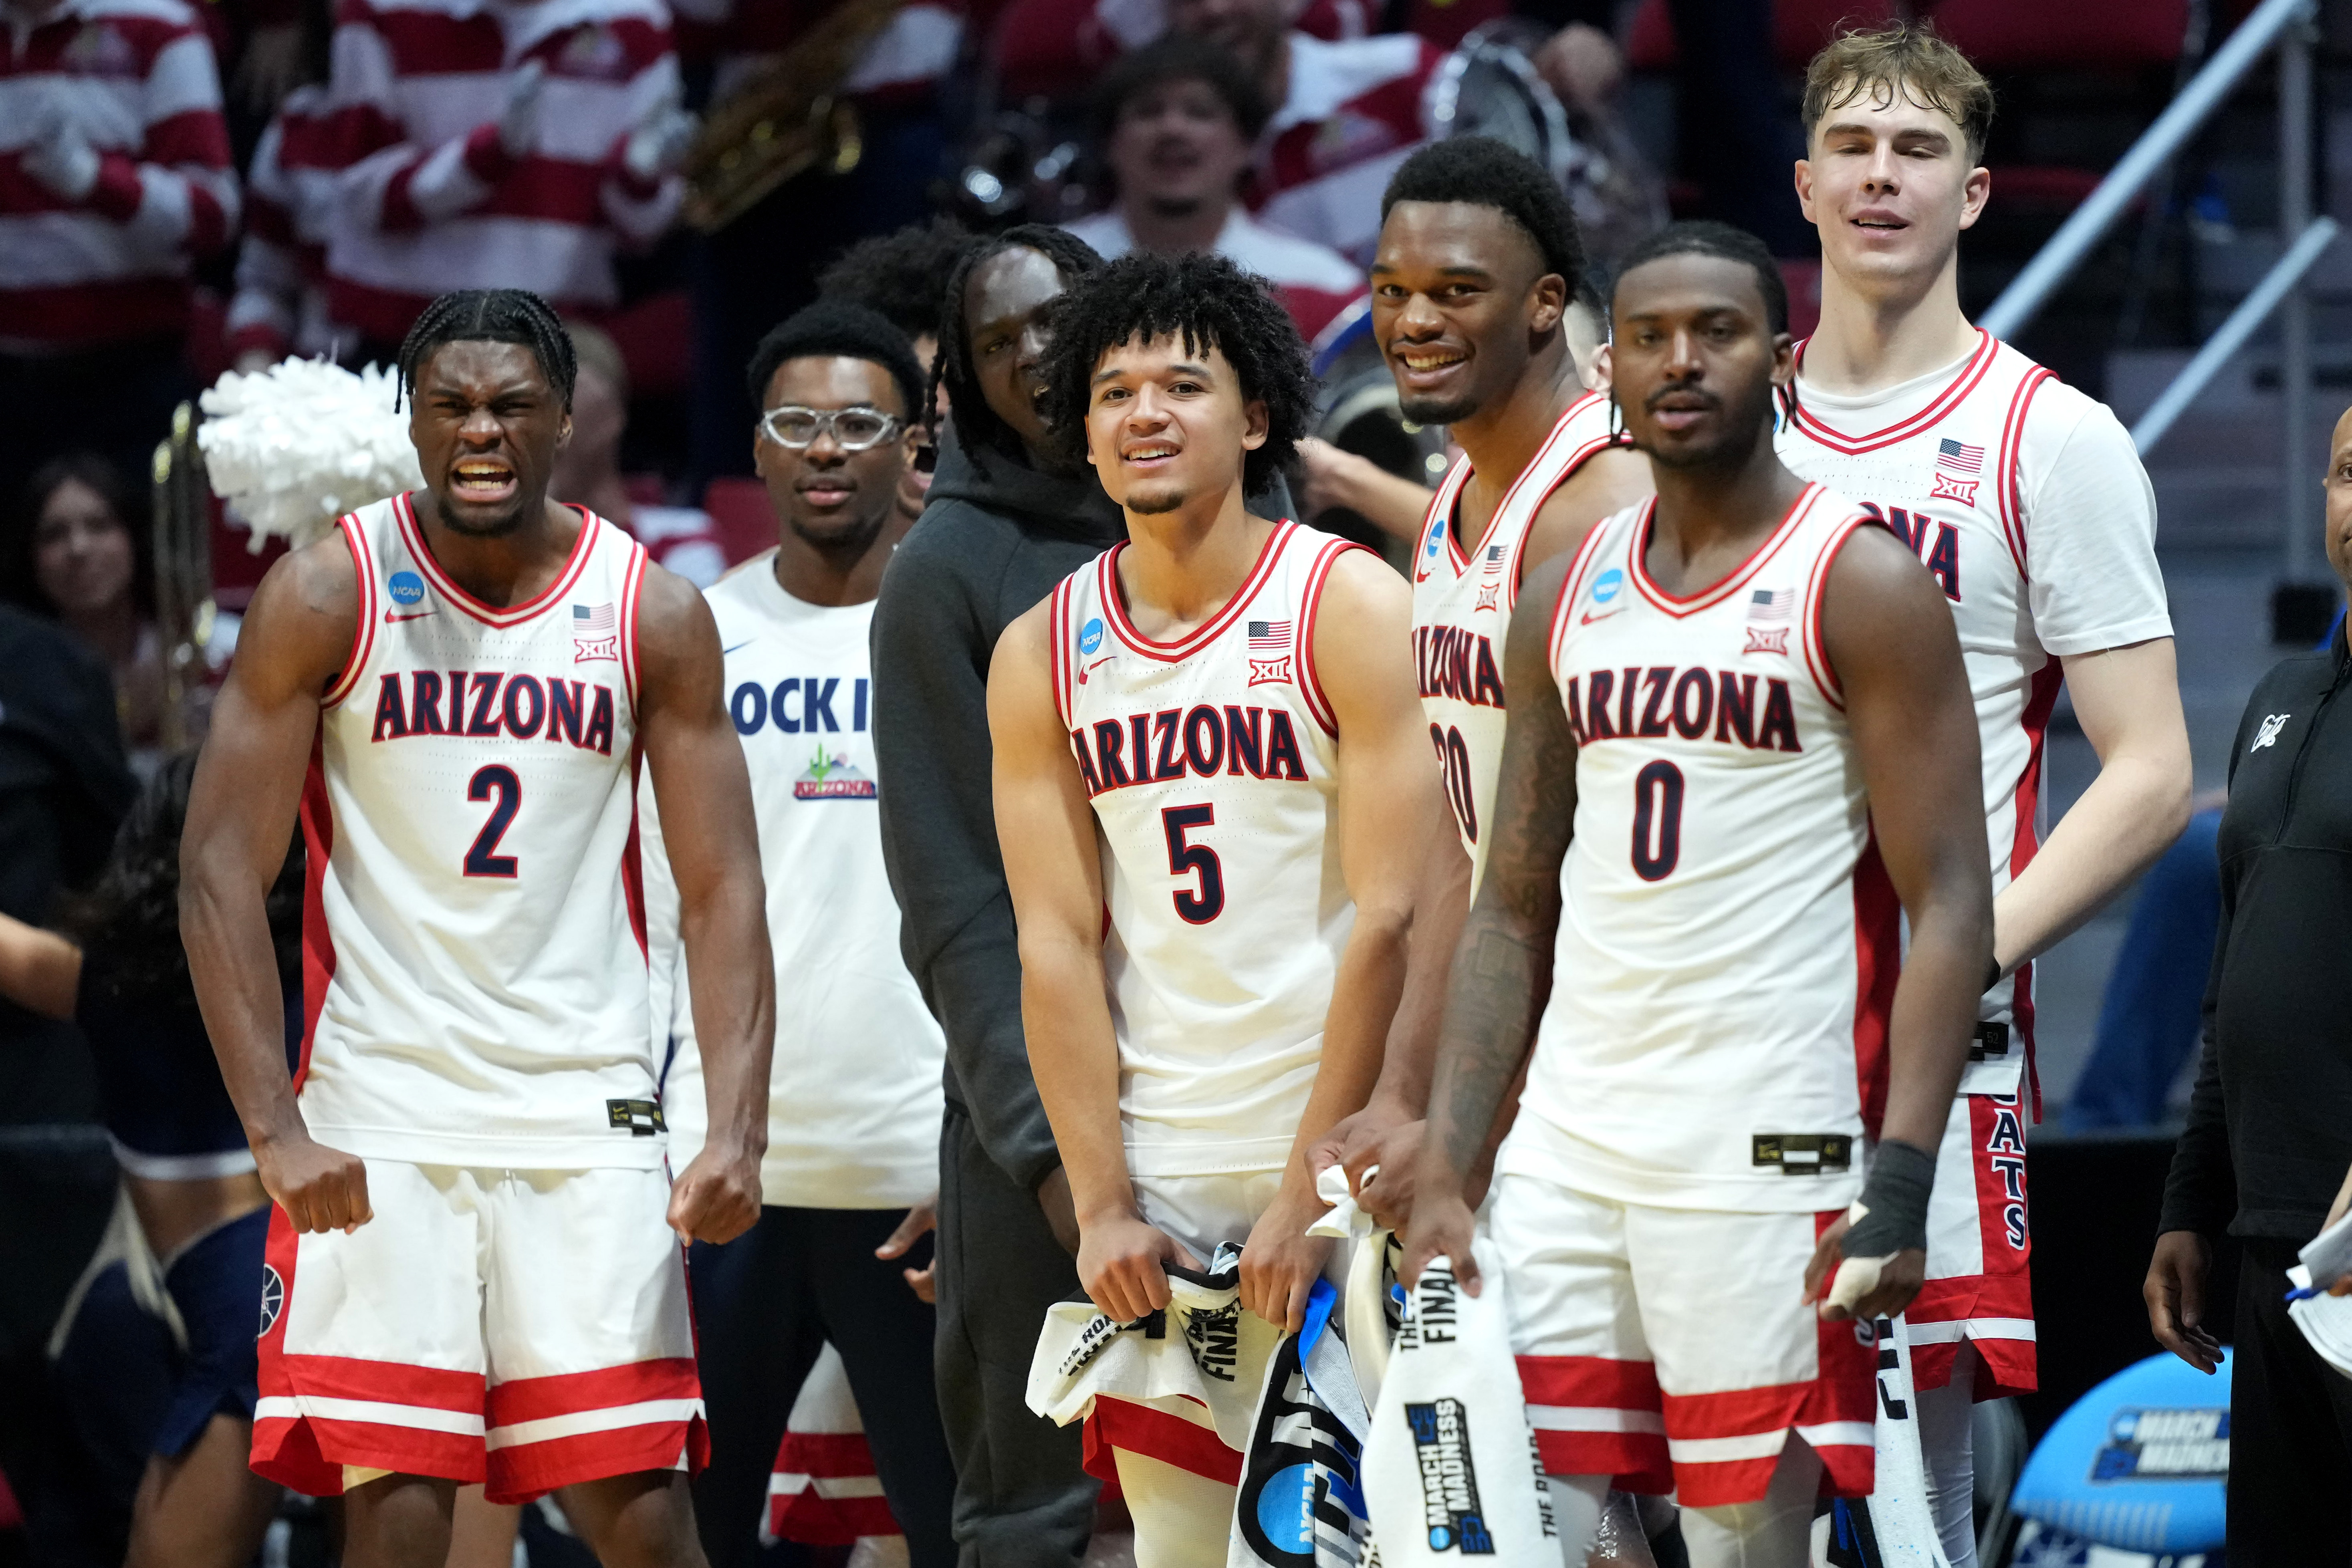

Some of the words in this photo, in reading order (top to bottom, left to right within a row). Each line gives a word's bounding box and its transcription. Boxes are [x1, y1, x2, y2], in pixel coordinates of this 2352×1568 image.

[1083, 631, 1101, 647] NCAA
[1412, 625, 1505, 709] IZONA
[371, 671, 614, 756] ARIZONA
[1072, 704, 1309, 800] ARIZONA
[1567, 667, 1802, 752] ARIZONA
[463, 764, 522, 879] 2
[1161, 802, 1225, 925] 5
[1631, 760, 1684, 882] 0
[1418, 1444, 1450, 1526] MARCH
[1435, 1399, 1472, 1512] MADNESS
